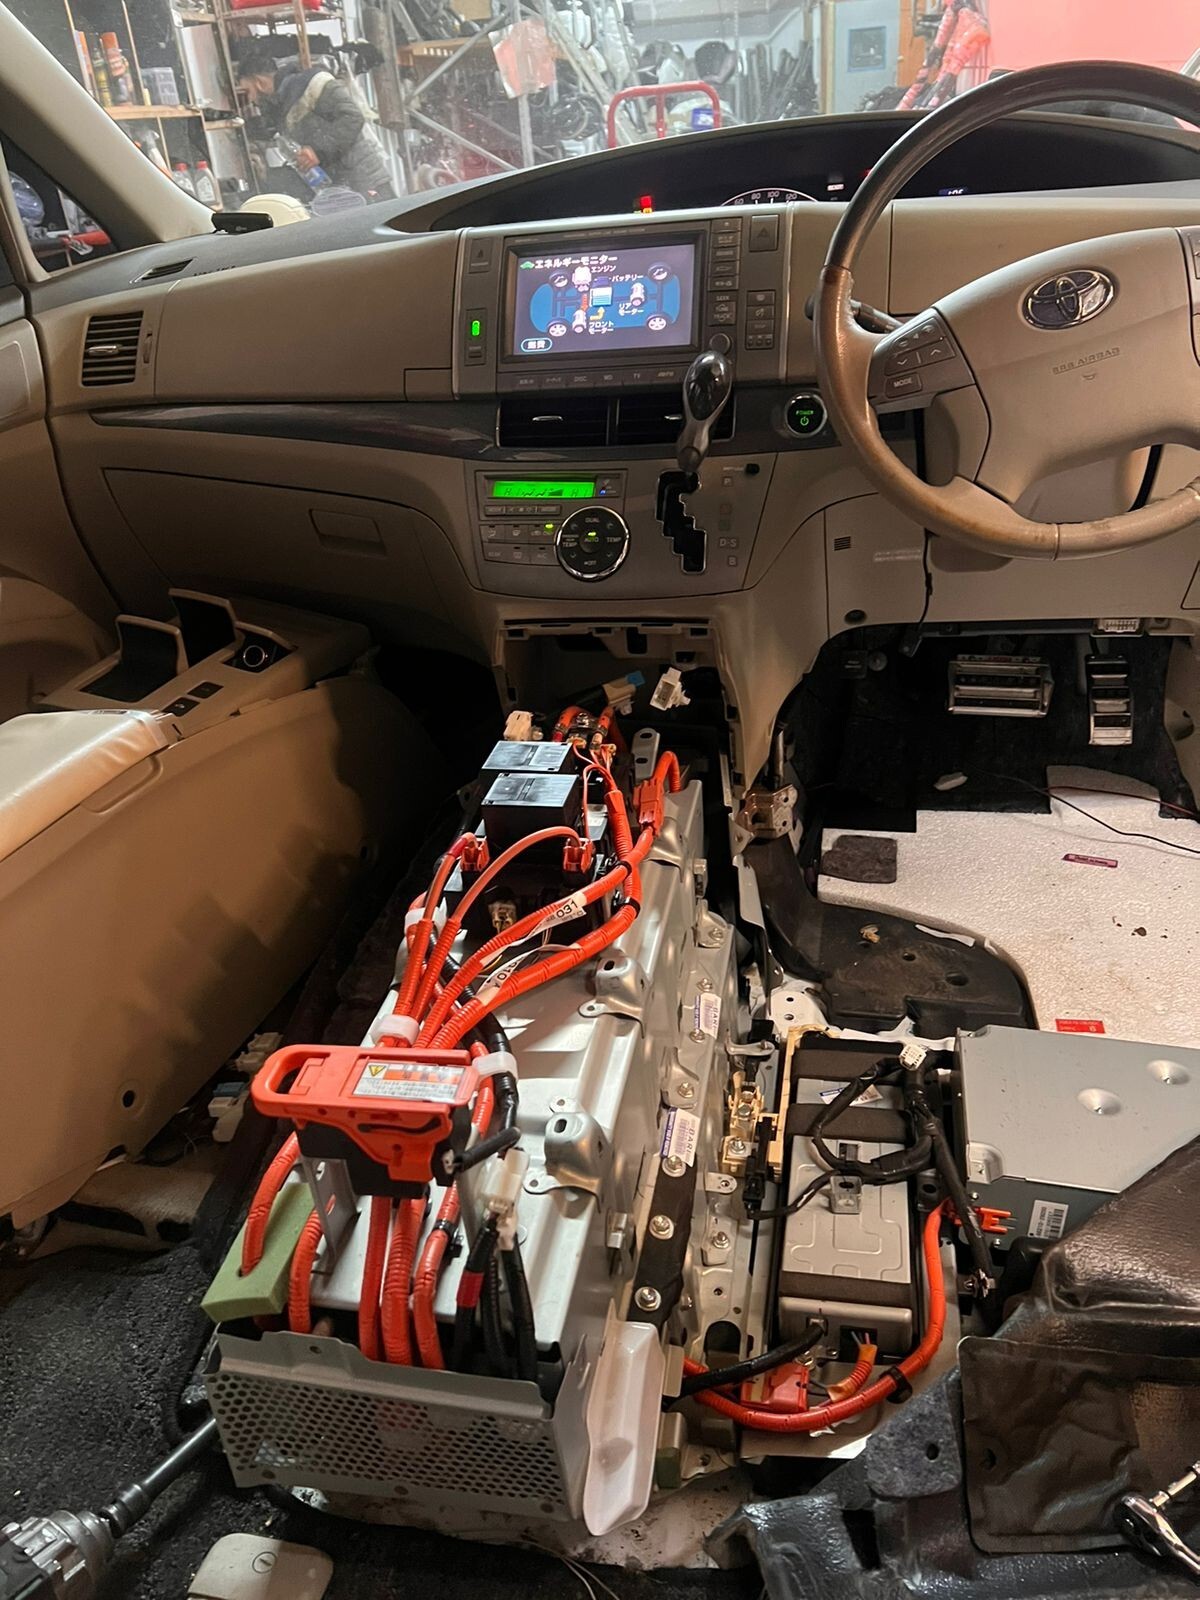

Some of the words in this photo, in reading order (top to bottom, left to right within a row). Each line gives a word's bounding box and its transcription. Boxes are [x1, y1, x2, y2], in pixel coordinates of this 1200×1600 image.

[535, 254, 618, 269] エネルギーモニター
[591, 264, 616, 273] エンジン
[611, 274, 644, 282] バッテリー
[618, 308, 644, 316] モーター
[588, 320, 614, 328] フロント
[588, 327, 614, 335] モーター
[894, 377, 912, 388] MODE
[556, 899, 578, 918] 031
